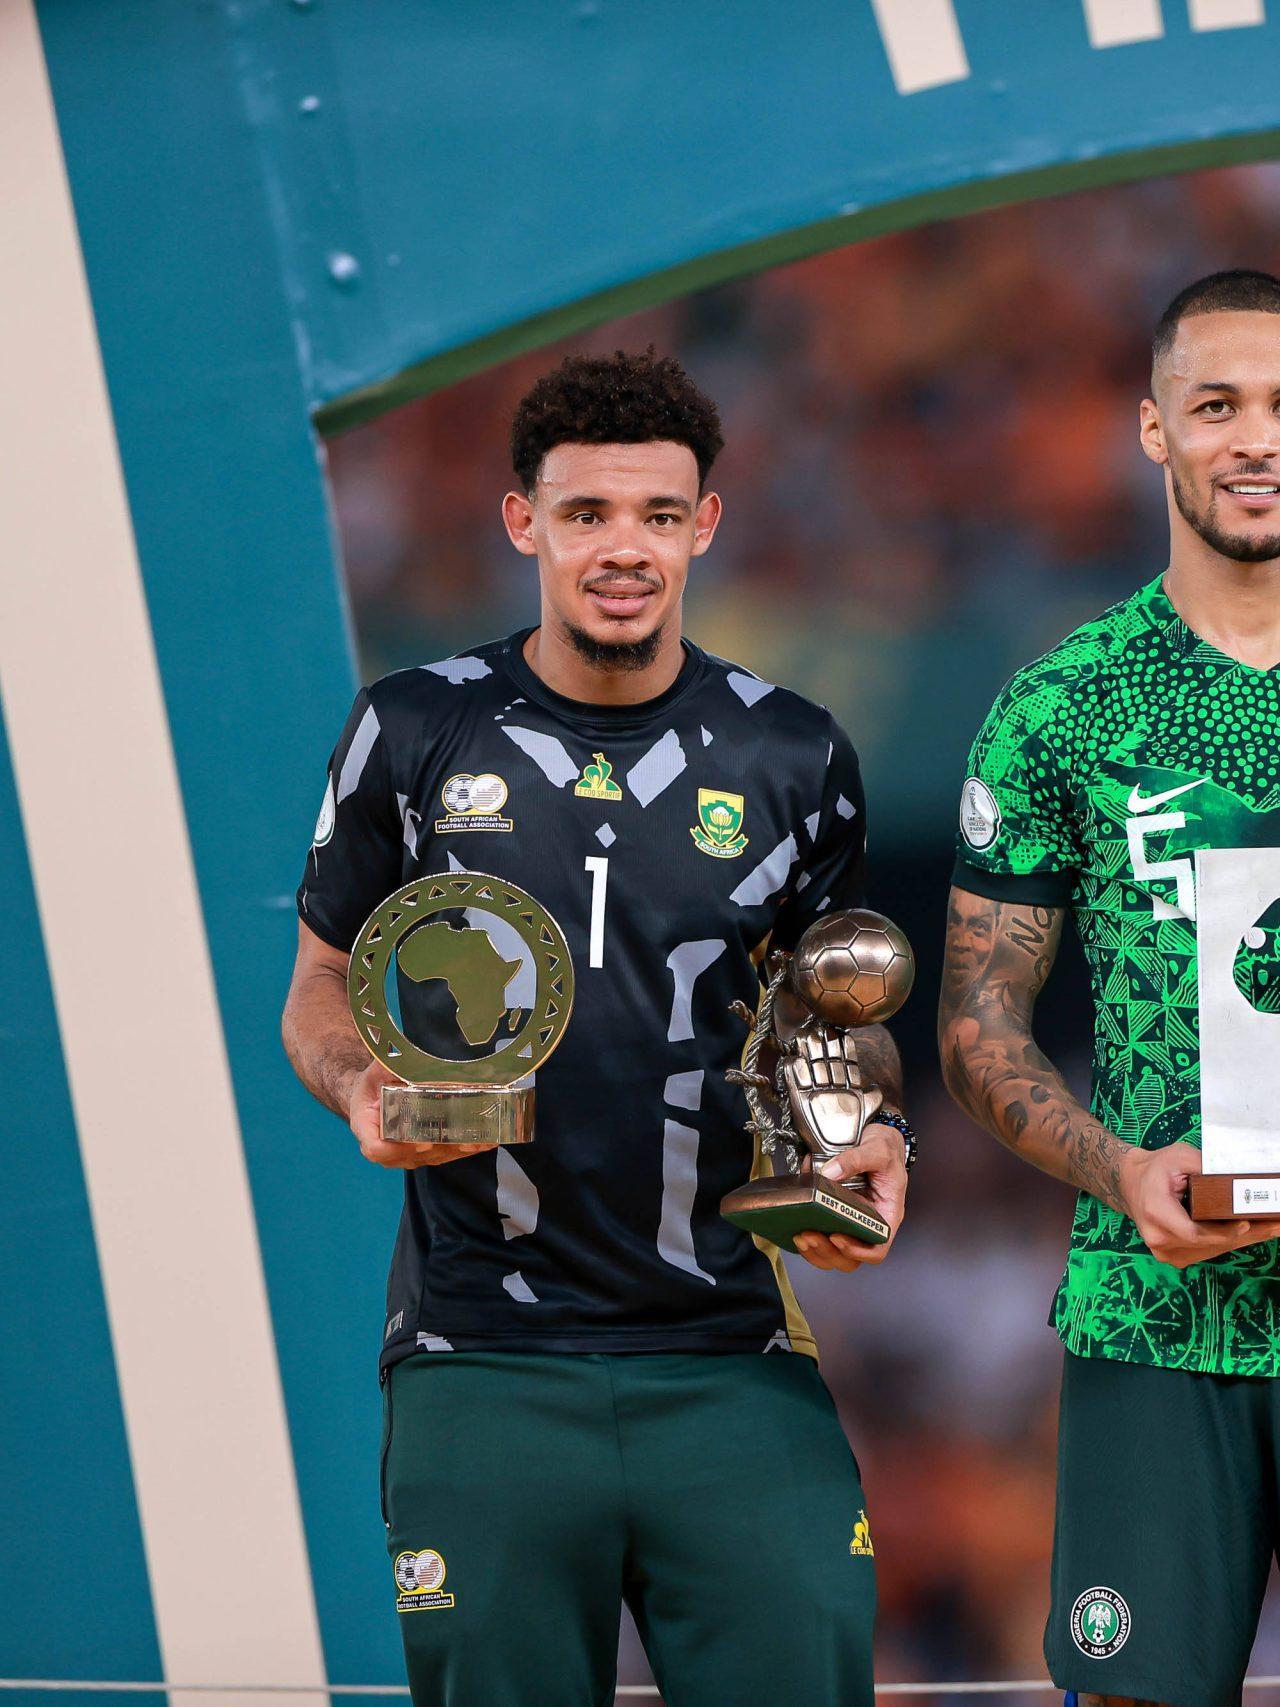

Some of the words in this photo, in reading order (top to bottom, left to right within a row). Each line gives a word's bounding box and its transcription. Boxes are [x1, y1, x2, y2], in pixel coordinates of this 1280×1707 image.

[1126, 811, 1197, 921] 5
[584, 856, 609, 968] 1
[821, 1194, 839, 1209] BEST
[840, 1204, 884, 1233] GOALKEEPER
[419, 1598, 451, 1607] ASSOCIATION
[1078, 1591, 1113, 1610] FOOTBALL
[1073, 1609, 1084, 1643] NIGERIA
[1113, 1597, 1127, 1648] FEDERATION
[1090, 1646, 1106, 1655] 1945
